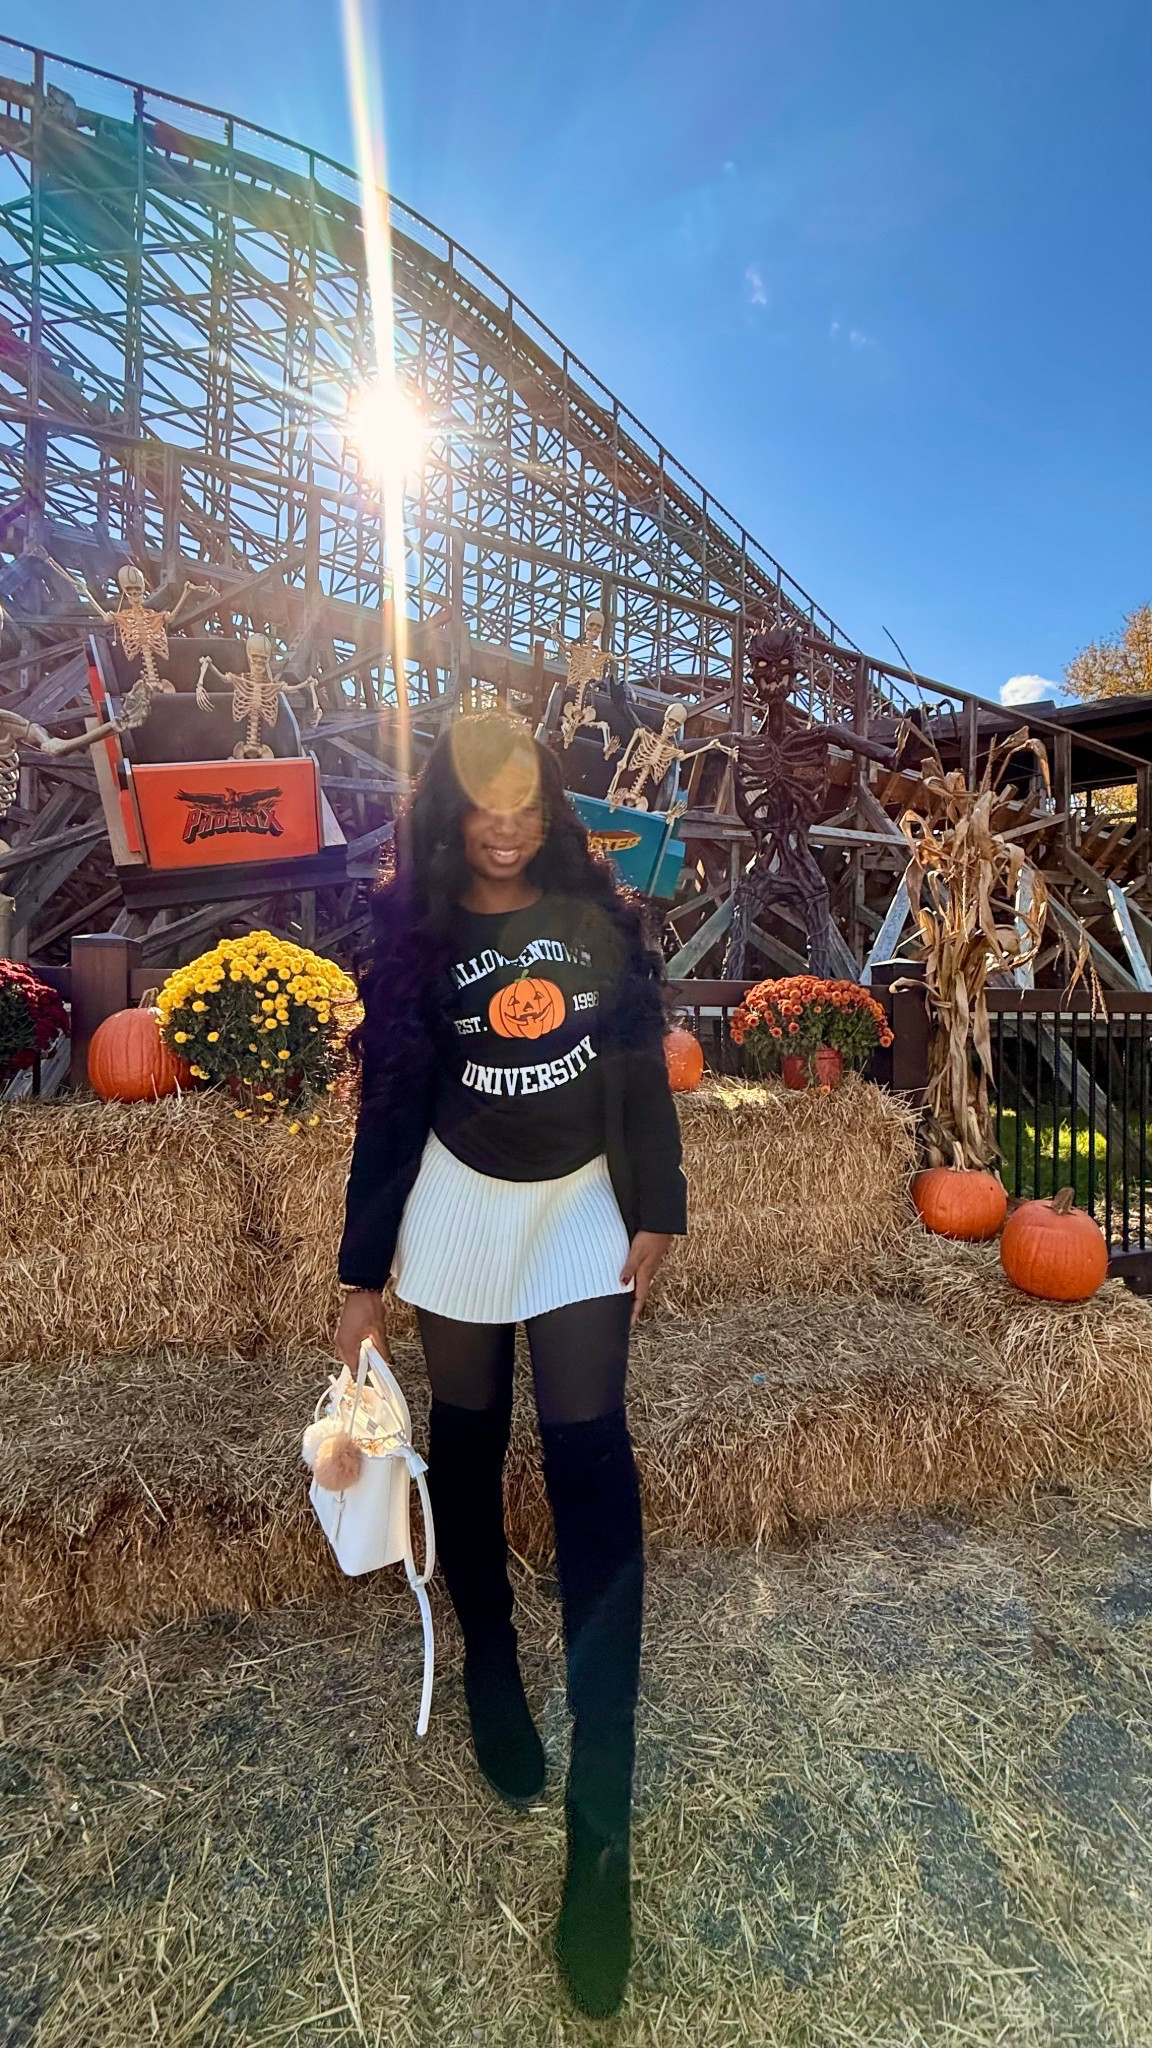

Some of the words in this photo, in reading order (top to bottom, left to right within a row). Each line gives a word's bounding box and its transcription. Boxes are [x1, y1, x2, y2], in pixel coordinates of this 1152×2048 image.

[182, 808, 284, 843] PHOENIX
[453, 1016, 488, 1035] EST.
[461, 1034, 598, 1097] UNIVERSITY
